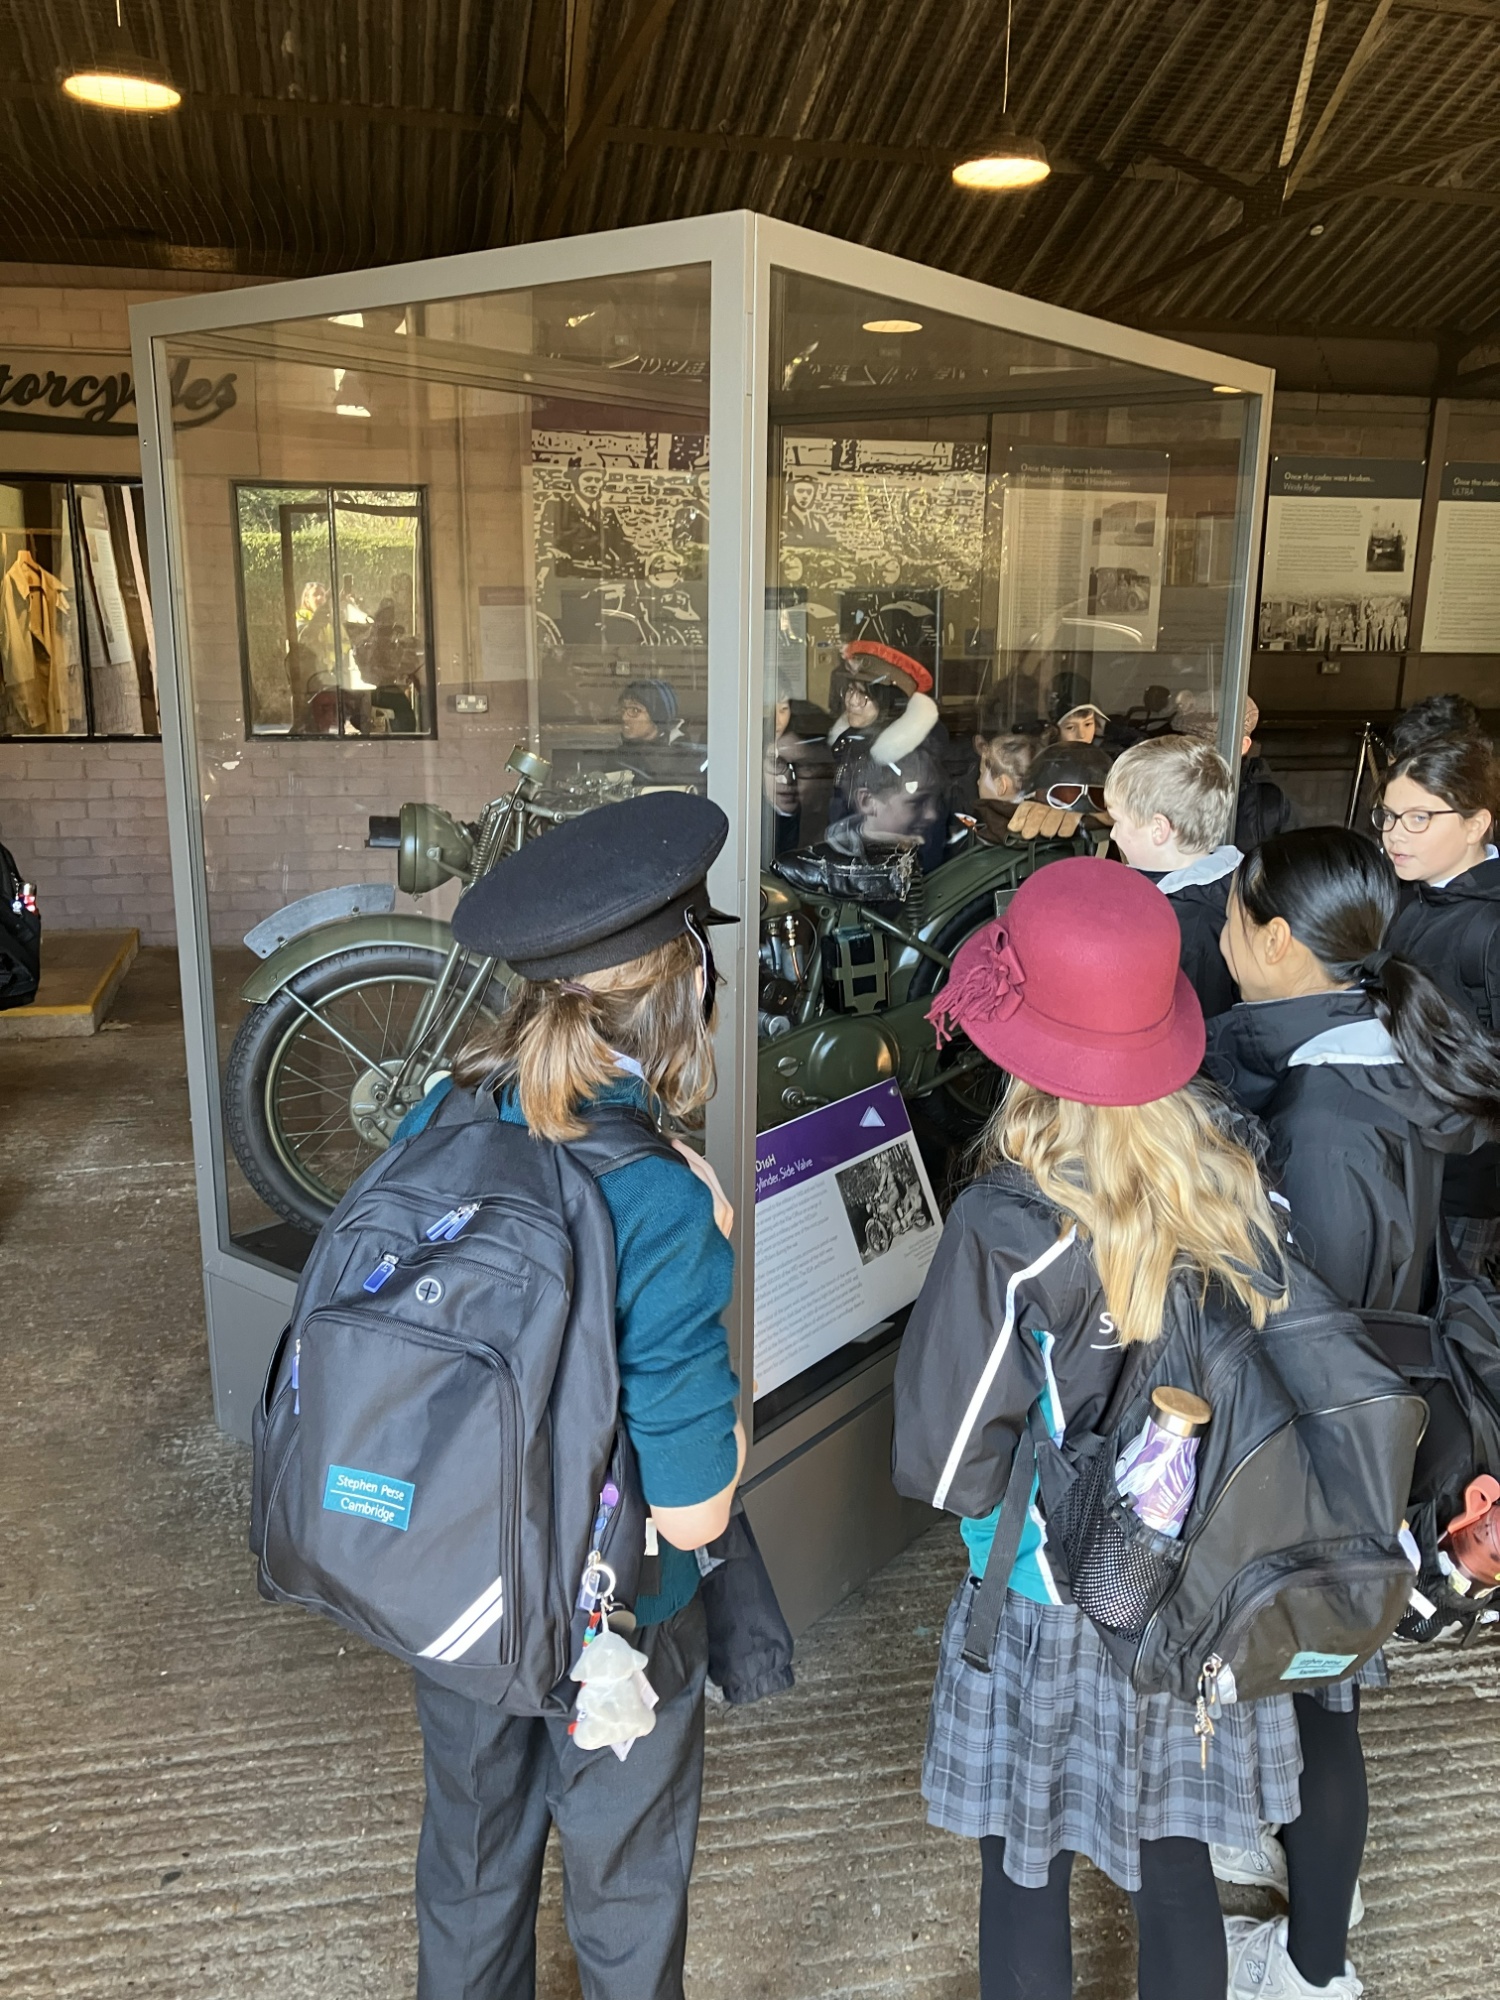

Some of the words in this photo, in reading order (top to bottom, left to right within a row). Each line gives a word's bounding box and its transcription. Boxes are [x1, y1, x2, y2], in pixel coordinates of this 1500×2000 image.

[780, 1164, 796, 1180] Side
[793, 1158, 814, 1172] Valve
[336, 1474, 378, 1493] Stephen
[381, 1484, 405, 1501] Perse
[340, 1497, 395, 1523] Cambridge
